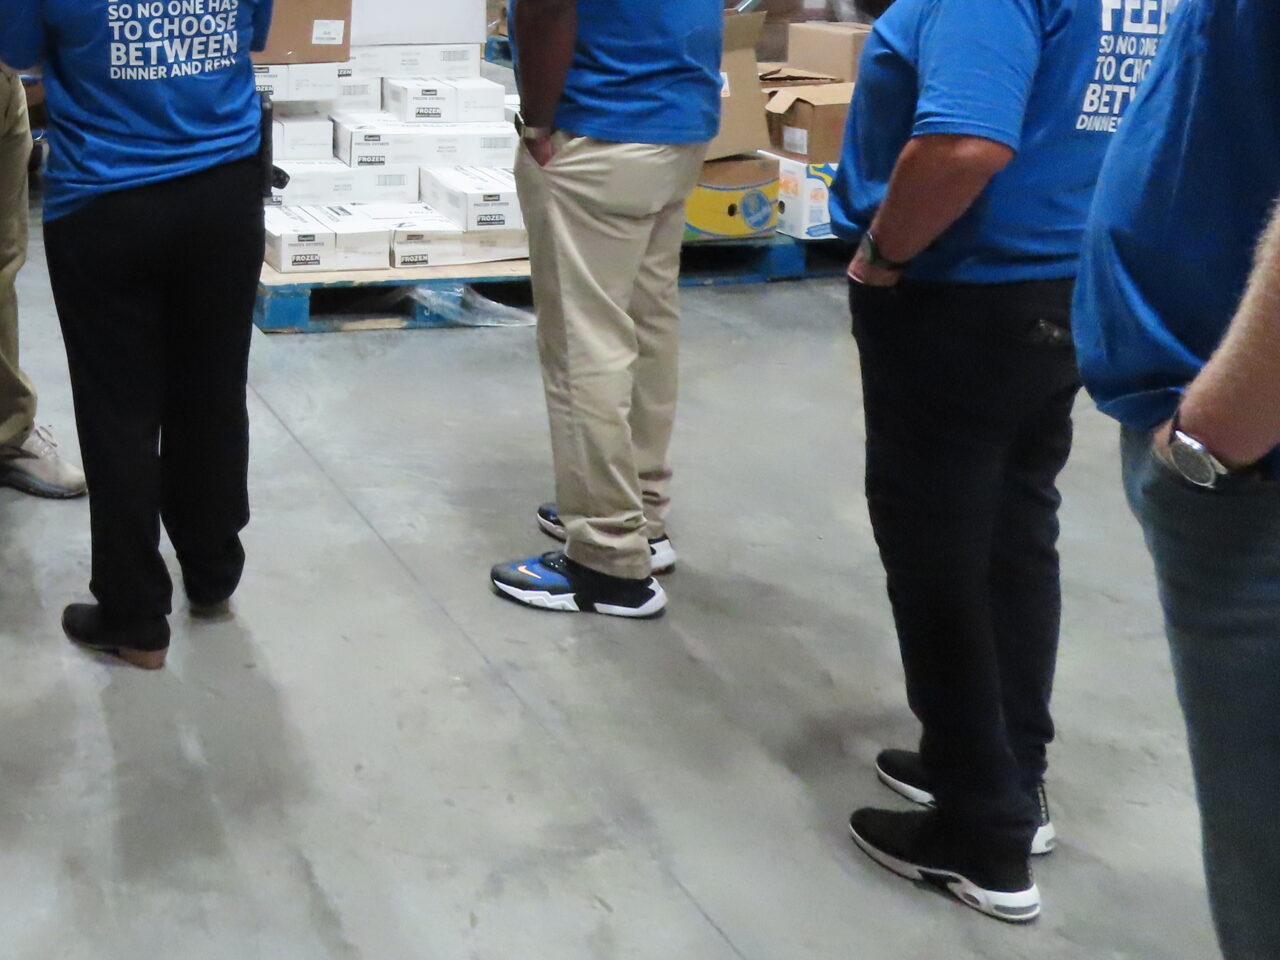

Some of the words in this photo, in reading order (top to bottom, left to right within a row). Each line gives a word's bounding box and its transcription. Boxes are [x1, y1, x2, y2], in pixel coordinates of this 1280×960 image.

[108, 4, 133, 20] SO
[137, 2, 163, 19] NO
[168, 0, 205, 16] ONE
[109, 20, 142, 41] TO
[148, 11, 238, 39] CHOOSE
[110, 31, 238, 66] BETWEEN
[1116, 36, 1136, 55] NO
[110, 66, 167, 81] DINNER
[171, 61, 201, 77] AND
[1094, 56, 1116, 81] TO
[477, 214, 505, 222] FROZEN
